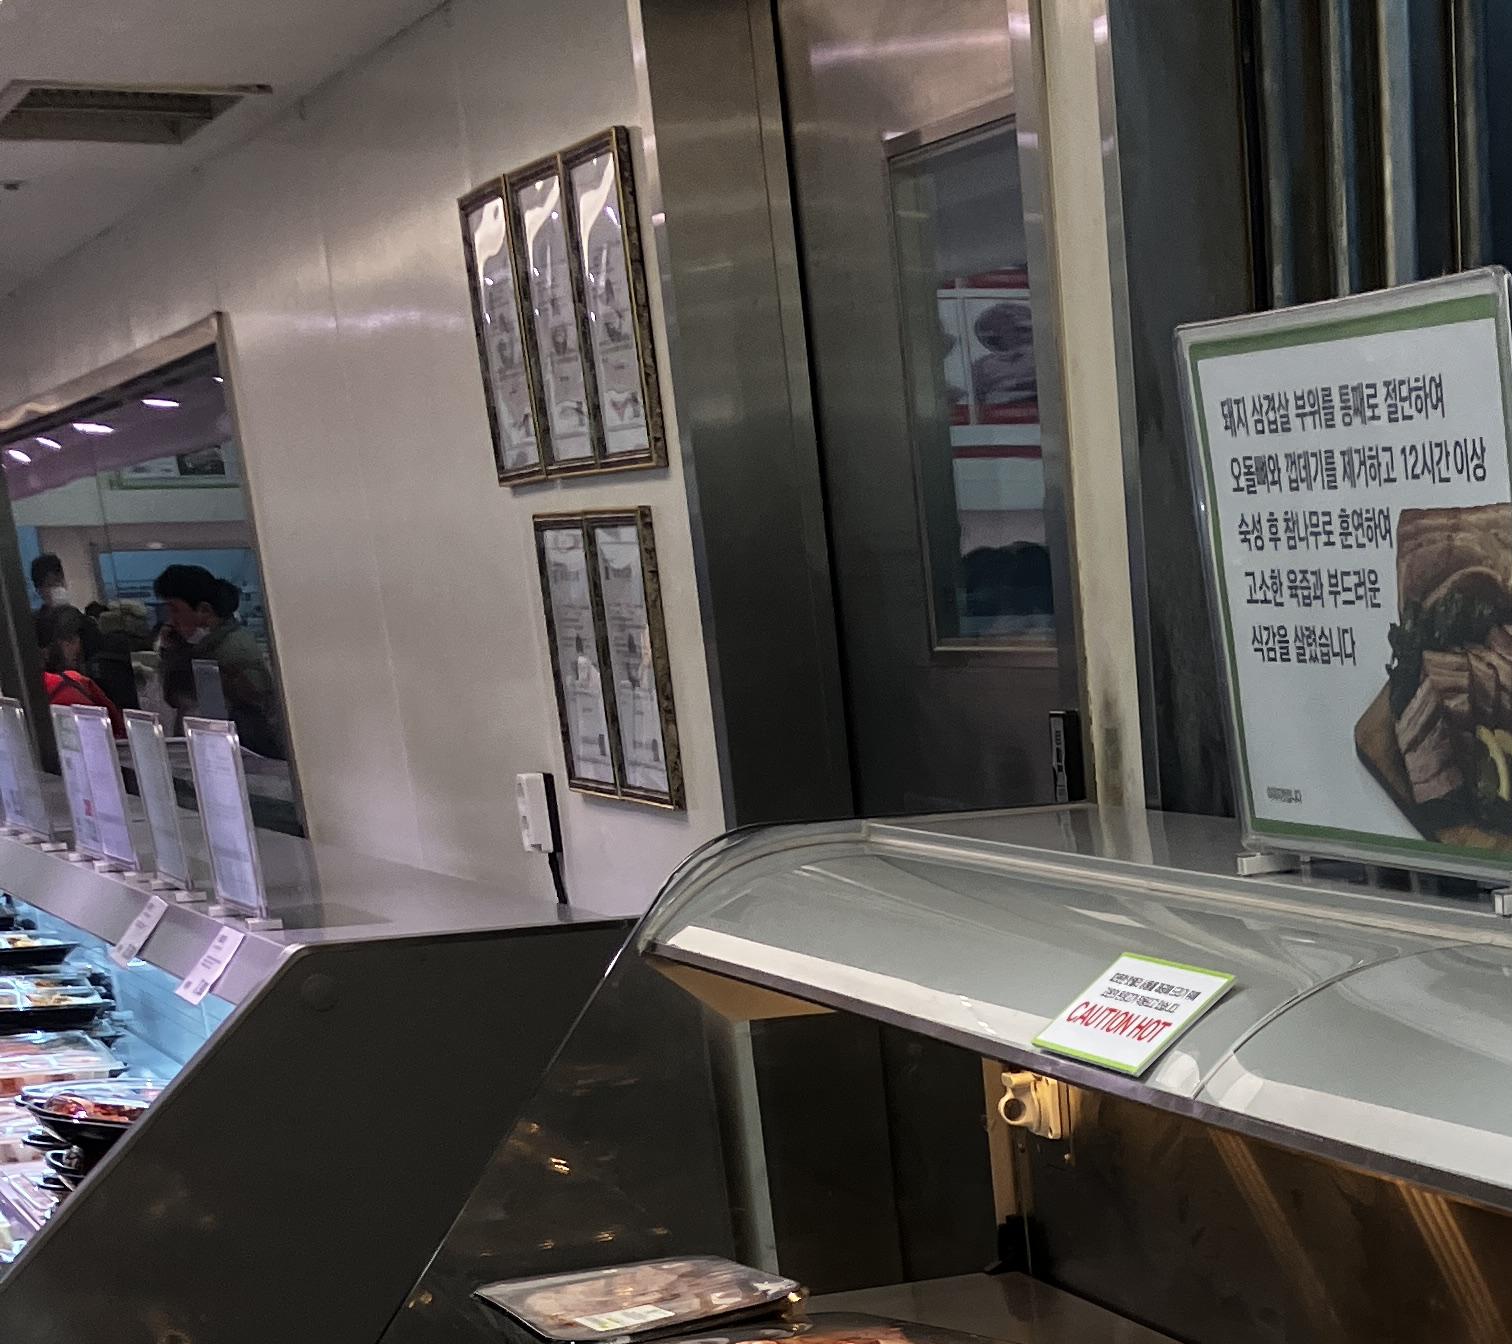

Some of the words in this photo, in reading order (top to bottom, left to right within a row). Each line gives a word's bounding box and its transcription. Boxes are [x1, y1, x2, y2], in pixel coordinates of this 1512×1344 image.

[1220, 397, 1250, 437] 돼지
[1251, 392, 1291, 435] 삼겹살
[1294, 386, 1336, 431] 부위를
[1338, 382, 1381, 426] 통째로
[1383, 372, 1445, 423] 절단하여
[1340, 443, 1397, 488] 제거하고
[1401, 439, 1451, 484] 12시간
[1453, 436, 1486, 482] 이상
[1238, 511, 1264, 551] 숙성
[1266, 511, 1281, 551] 후
[1284, 510, 1336, 550] 참나무로
[1338, 506, 1393, 549] 훈연하여
[1245, 568, 1284, 607] 고소한
[1287, 568, 1325, 608] 육즙과
[1327, 568, 1381, 608] 부드러운
[1252, 624, 1291, 663] 식감을
[1066, 1001, 1135, 1036] CAUTION
[1128, 1014, 1173, 1043] HOT
